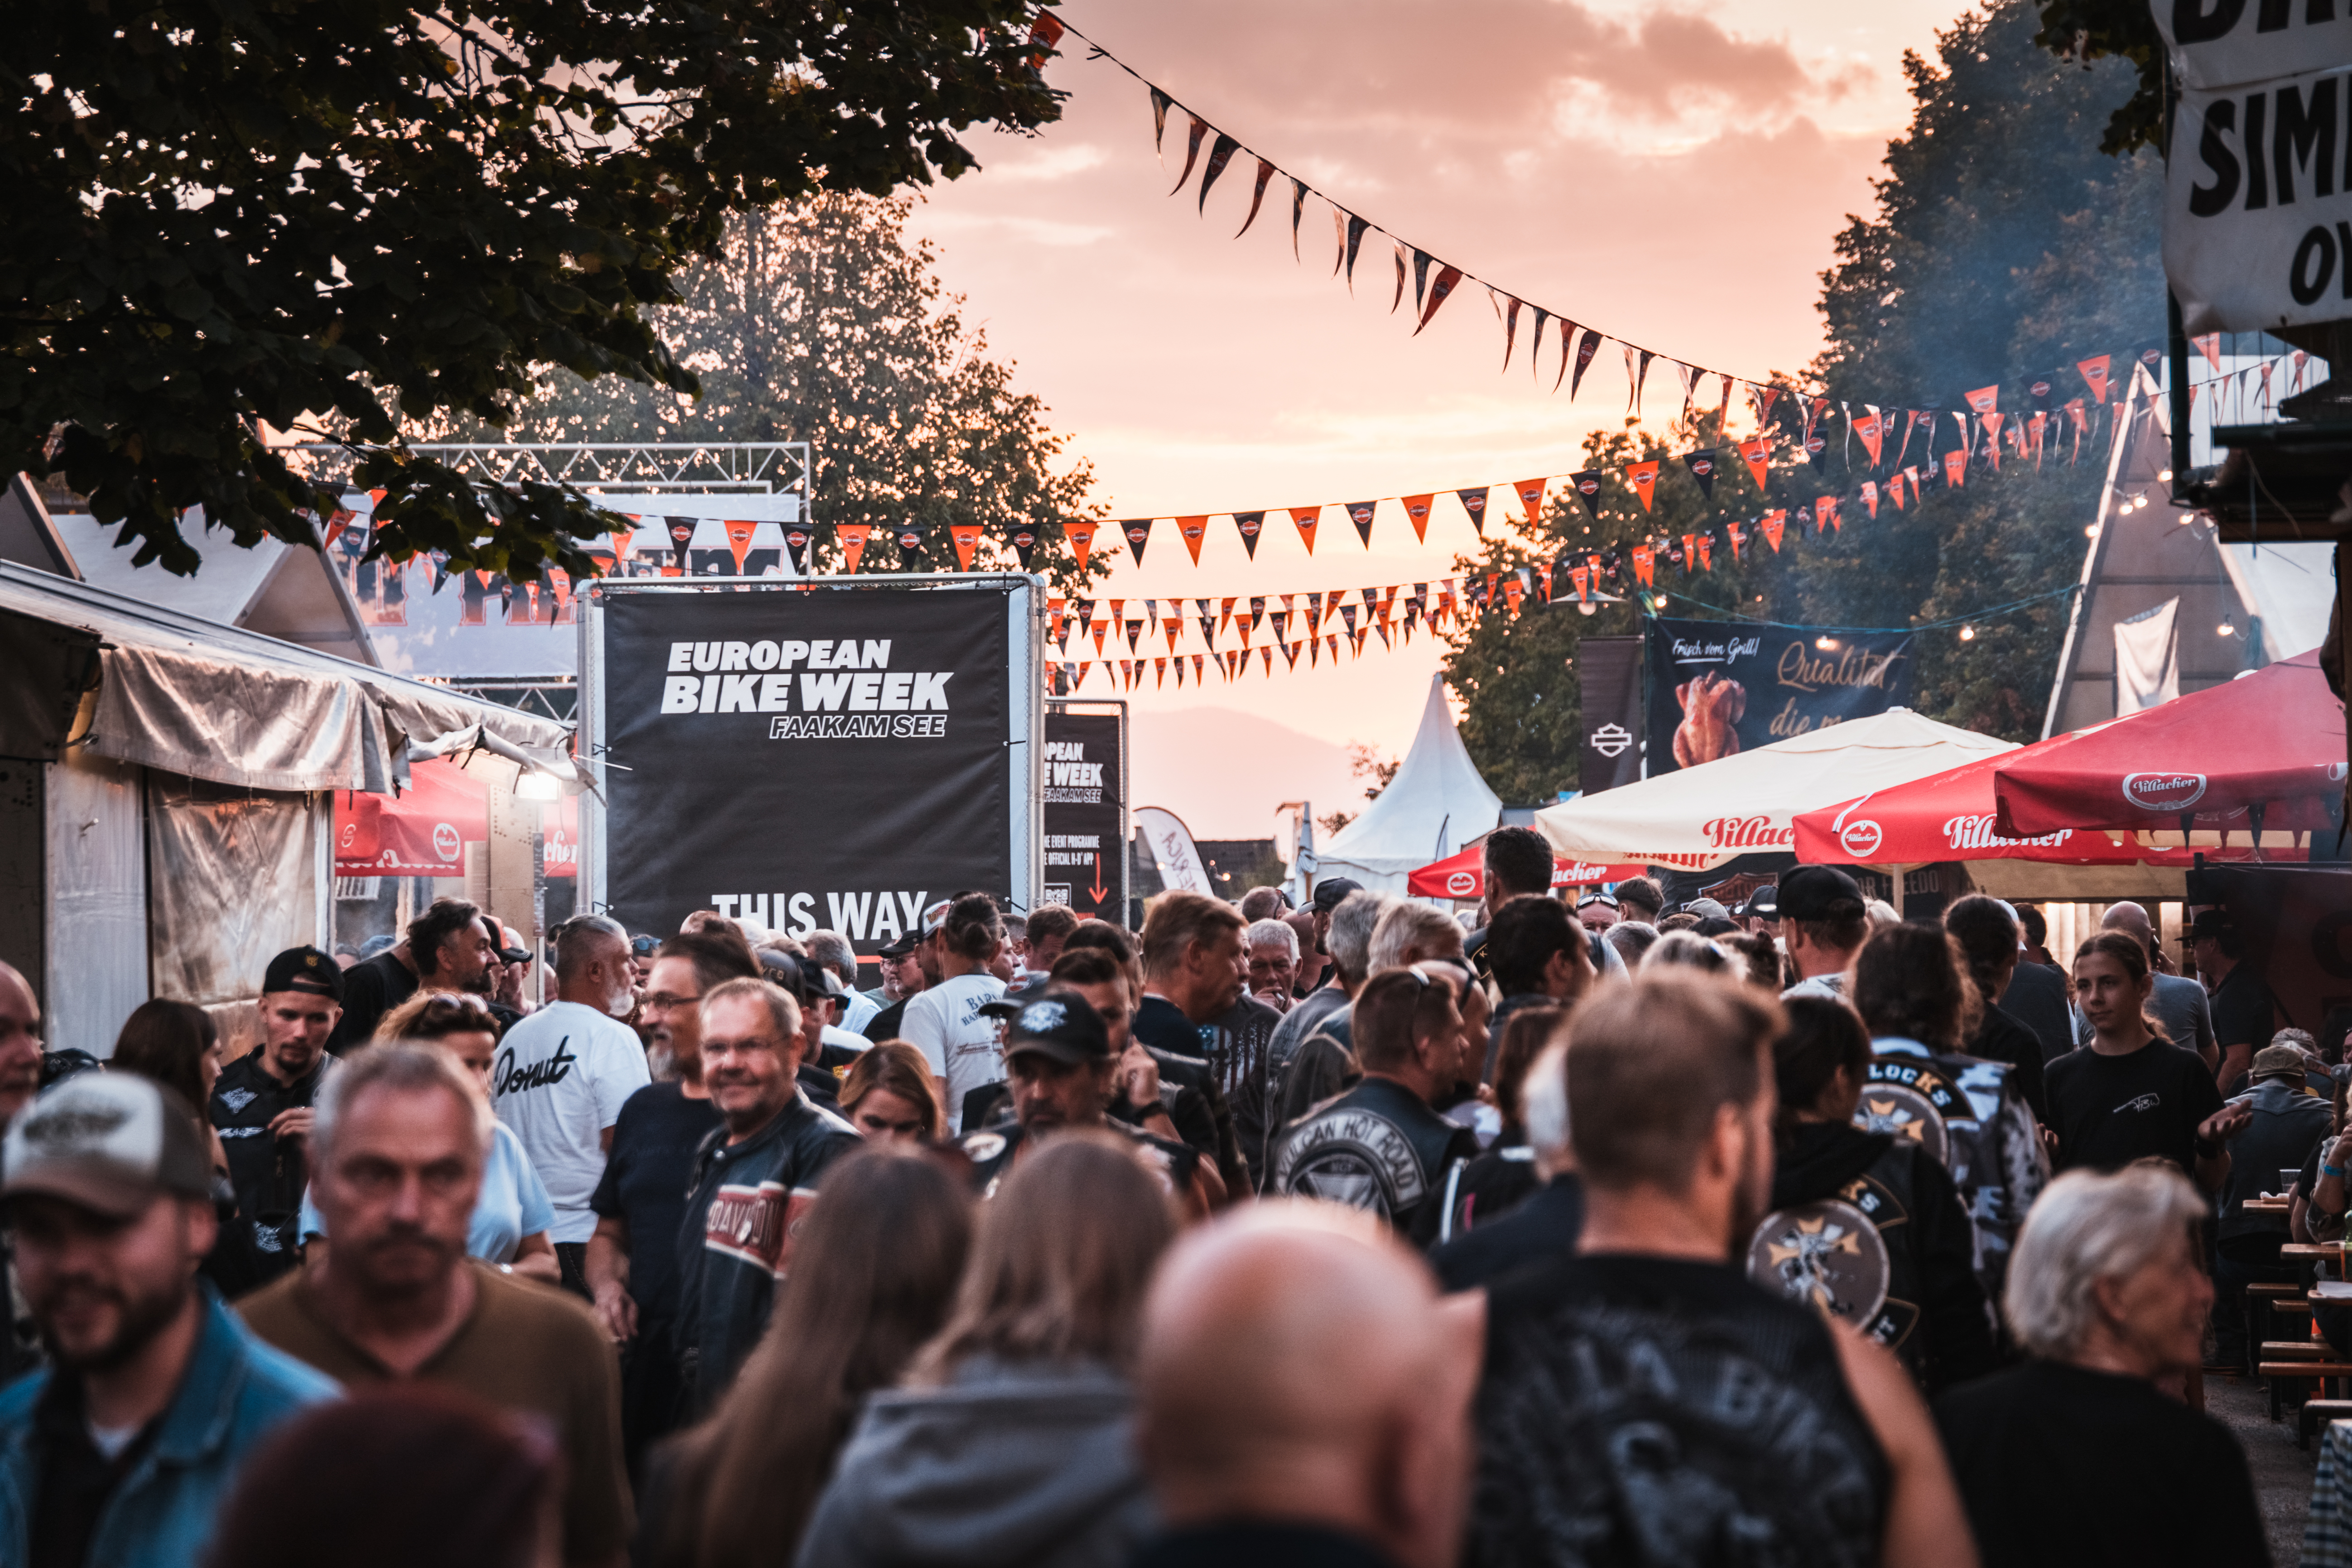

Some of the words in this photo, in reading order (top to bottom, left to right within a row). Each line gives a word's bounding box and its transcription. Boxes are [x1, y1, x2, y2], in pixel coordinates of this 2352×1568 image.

[2189, 74, 2352, 218] SIM
[668, 640, 891, 672] EUROPEAN
[1672, 638, 1703, 657] Frisch
[1705, 641, 1726, 655] vom
[660, 673, 792, 714] BIKE
[800, 672, 954, 711] WEEK
[770, 716, 844, 739] FAAK
[842, 715, 890, 738] AM
[891, 714, 948, 738] SEE
[1044, 742, 1084, 761] PEAN
[1053, 762, 1103, 787] WEEK
[2133, 777, 2197, 793] Villacher
[1083, 788, 1102, 803] SEE
[1052, 835, 1067, 848] EVENT
[1068, 835, 1100, 848] PROGRAMME
[1703, 815, 1794, 848] Villac
[1049, 852, 1070, 865] OFFICIAL
[1083, 852, 1094, 866] APP
[1551, 861, 1607, 883] acher
[712, 892, 816, 941] THIS
[827, 891, 928, 940] WAY
